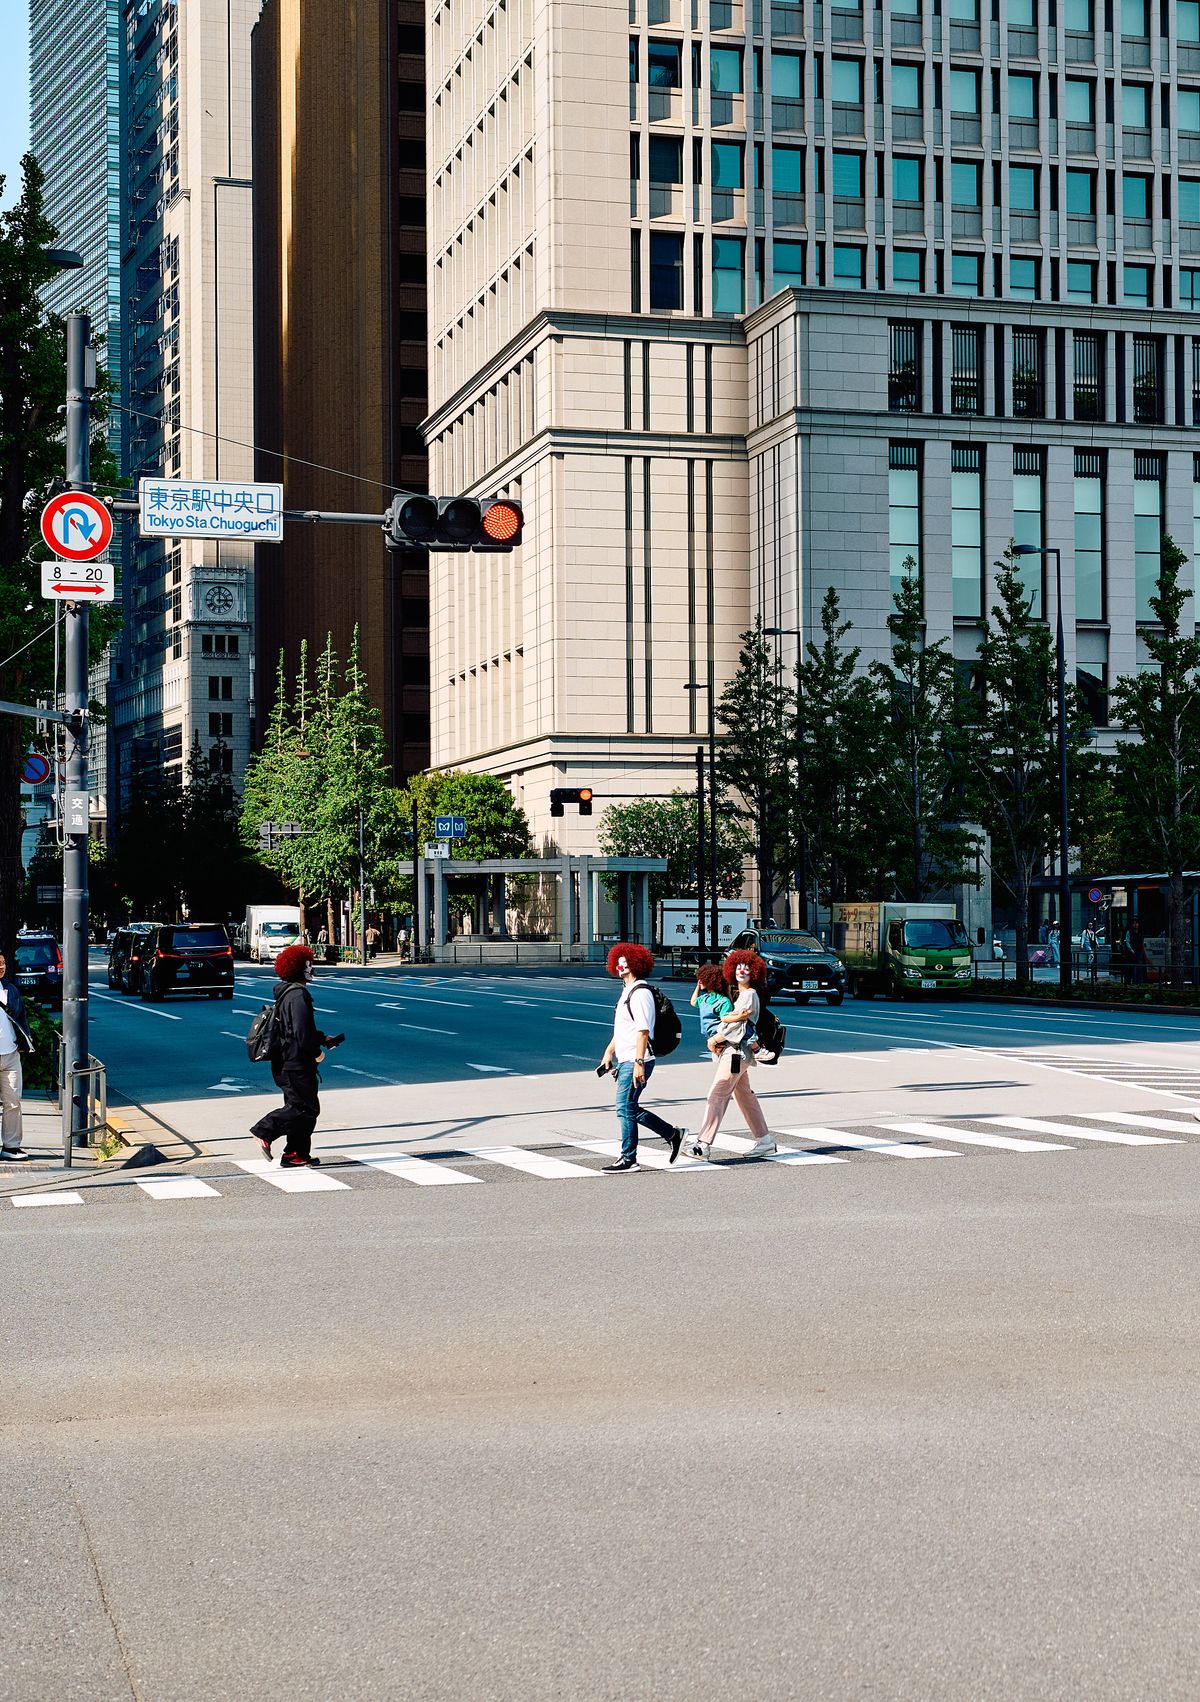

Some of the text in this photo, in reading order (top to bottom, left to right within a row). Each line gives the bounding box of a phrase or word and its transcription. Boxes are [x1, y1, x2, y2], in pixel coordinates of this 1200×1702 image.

[149, 486, 274, 514] 東京駅中央口
[147, 514, 184, 530] Tokyo
[209, 516, 277, 533] Chuoguchi
[53, 566, 62, 579] 8
[85, 568, 103, 581] 20
[71, 797, 84, 826] 交通
